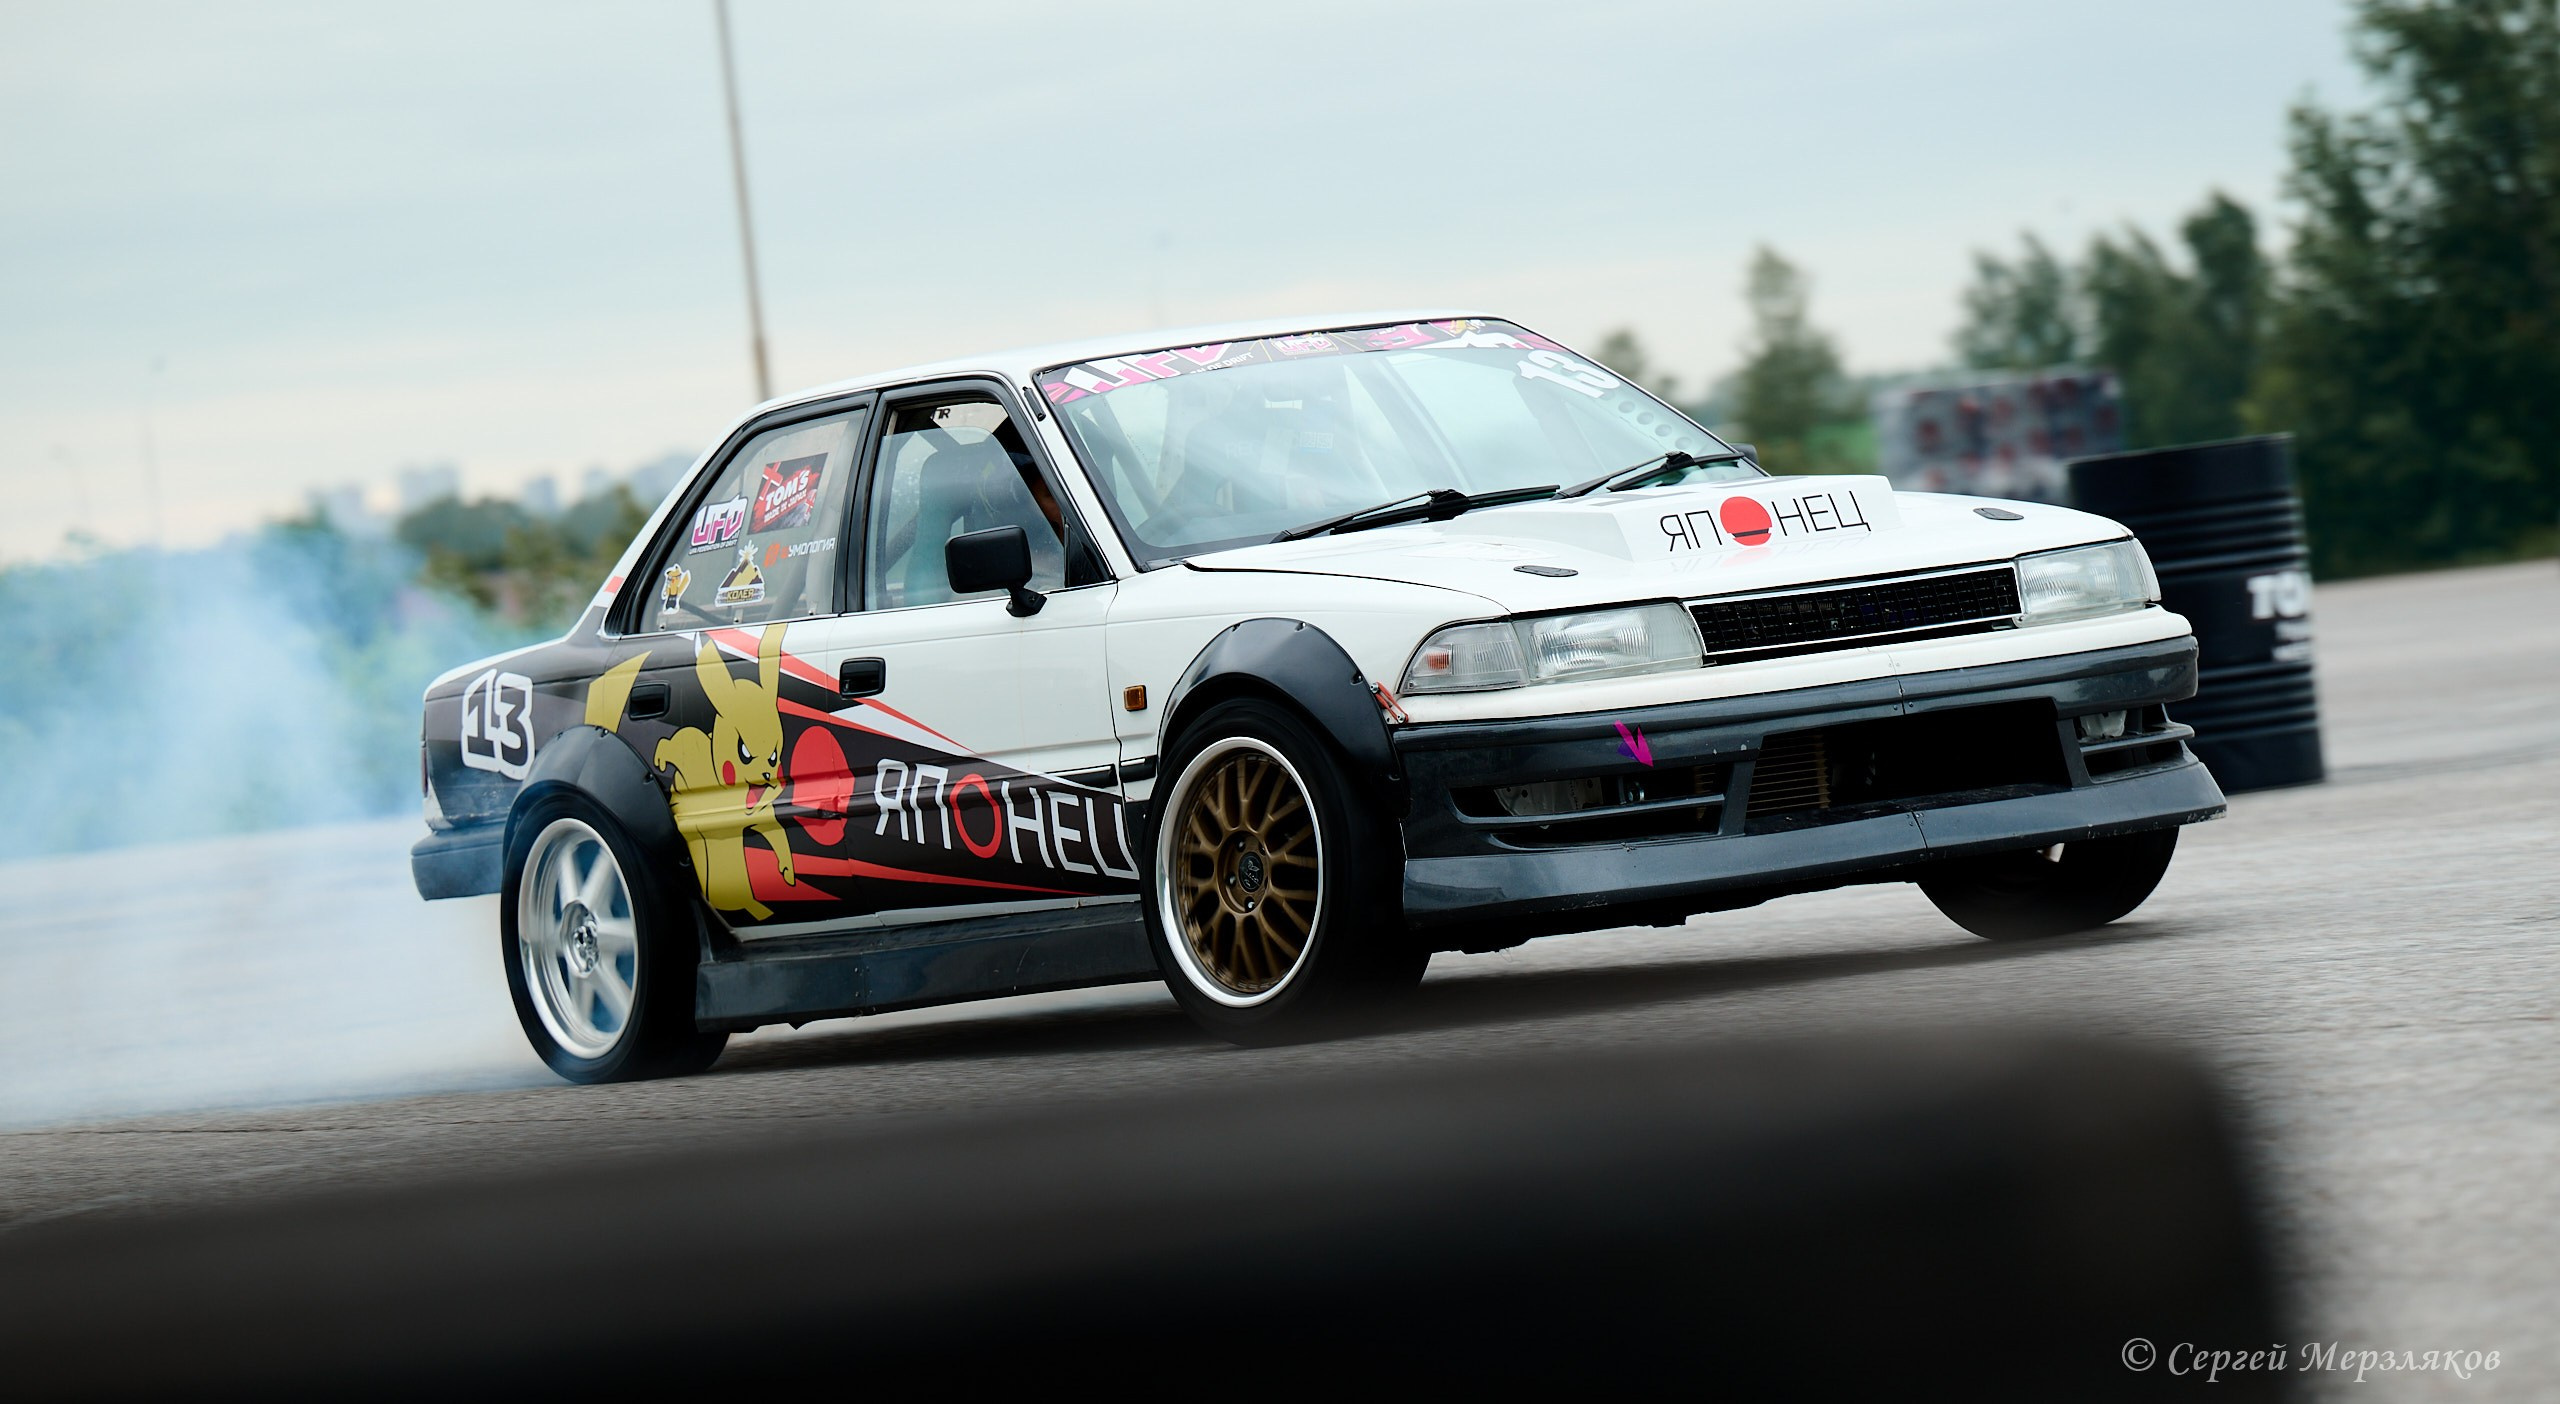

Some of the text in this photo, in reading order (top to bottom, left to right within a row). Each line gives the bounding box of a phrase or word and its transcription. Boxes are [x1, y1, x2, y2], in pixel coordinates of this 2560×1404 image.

[1223, 352, 1255, 368] DRIFT
[1516, 349, 1621, 399] 13
[462, 669, 535, 780] 13
